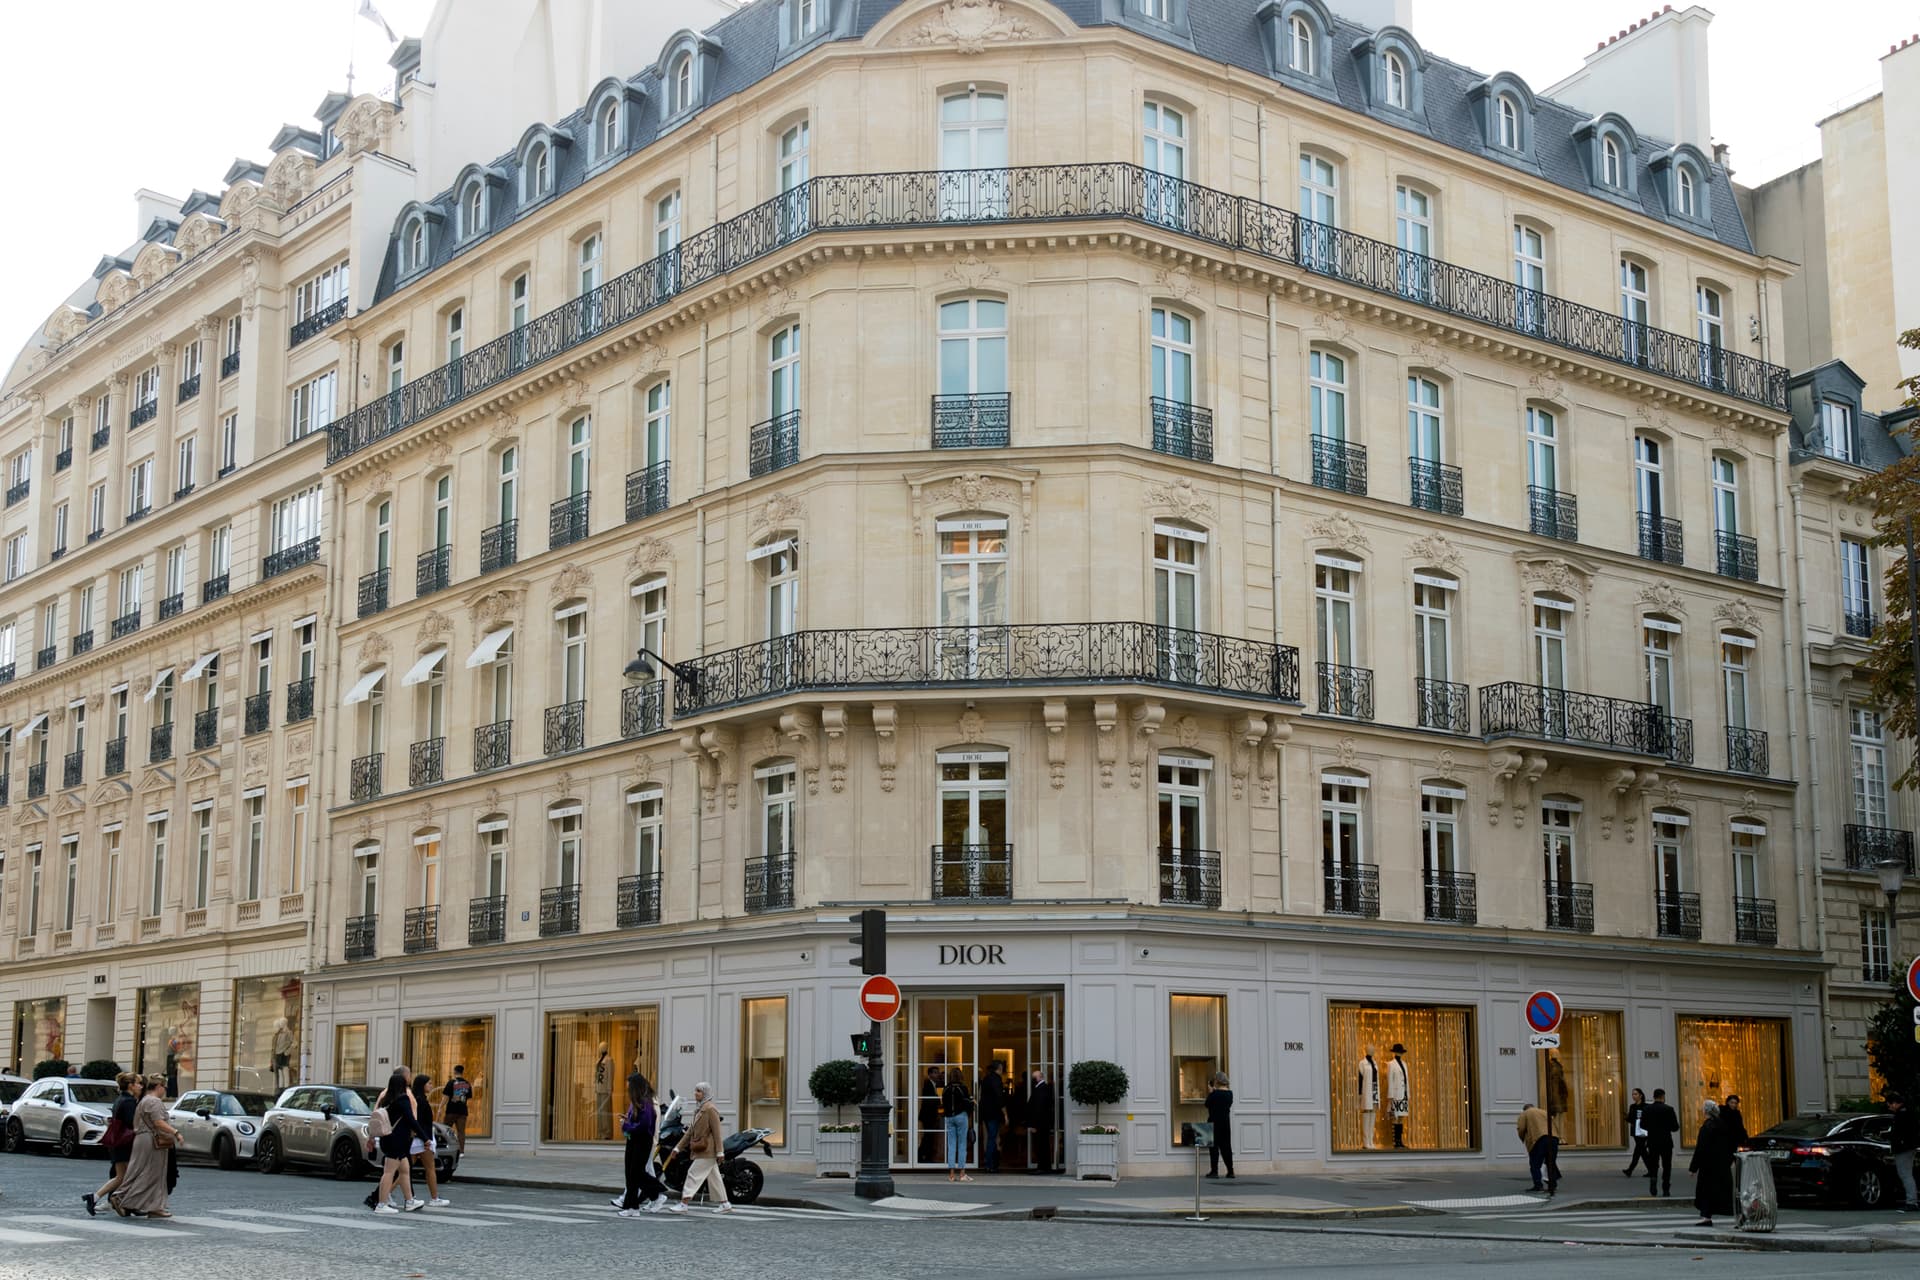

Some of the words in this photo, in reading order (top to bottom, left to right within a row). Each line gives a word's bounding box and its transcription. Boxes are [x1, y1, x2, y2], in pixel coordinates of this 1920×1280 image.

[938, 944, 1006, 965] DIOR
[680, 1045, 695, 1053] DIOR
[1284, 1042, 1304, 1052] DIOR
[1499, 1048, 1517, 1056] DIOR
